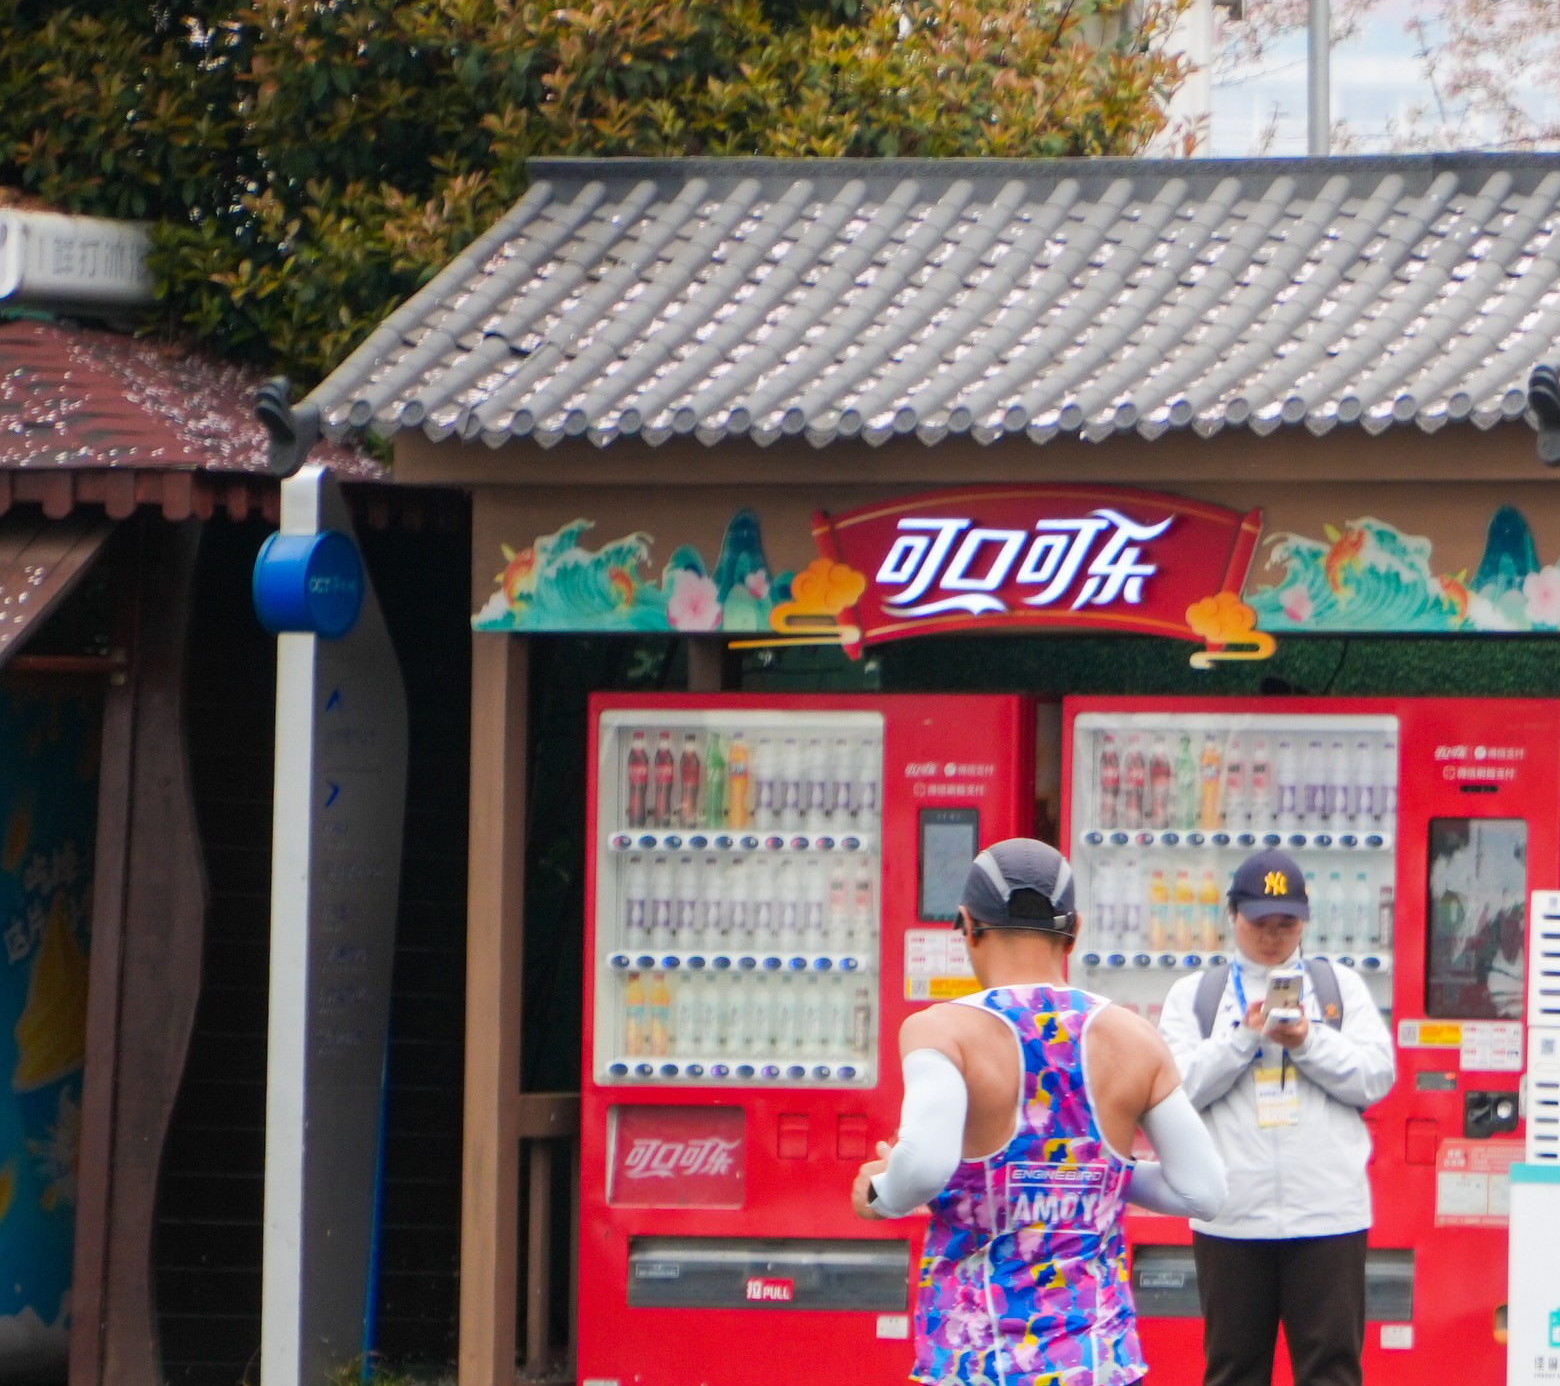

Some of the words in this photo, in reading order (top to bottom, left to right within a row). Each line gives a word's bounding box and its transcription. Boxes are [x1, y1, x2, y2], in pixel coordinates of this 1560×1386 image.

[876, 509, 1176, 617] 可口可乐
[1264, 871, 1288, 896] NY
[624, 1137, 742, 1180] 可口可乐
[1011, 1190, 1100, 1224] AMOY
[762, 1285, 790, 1300] PULL
